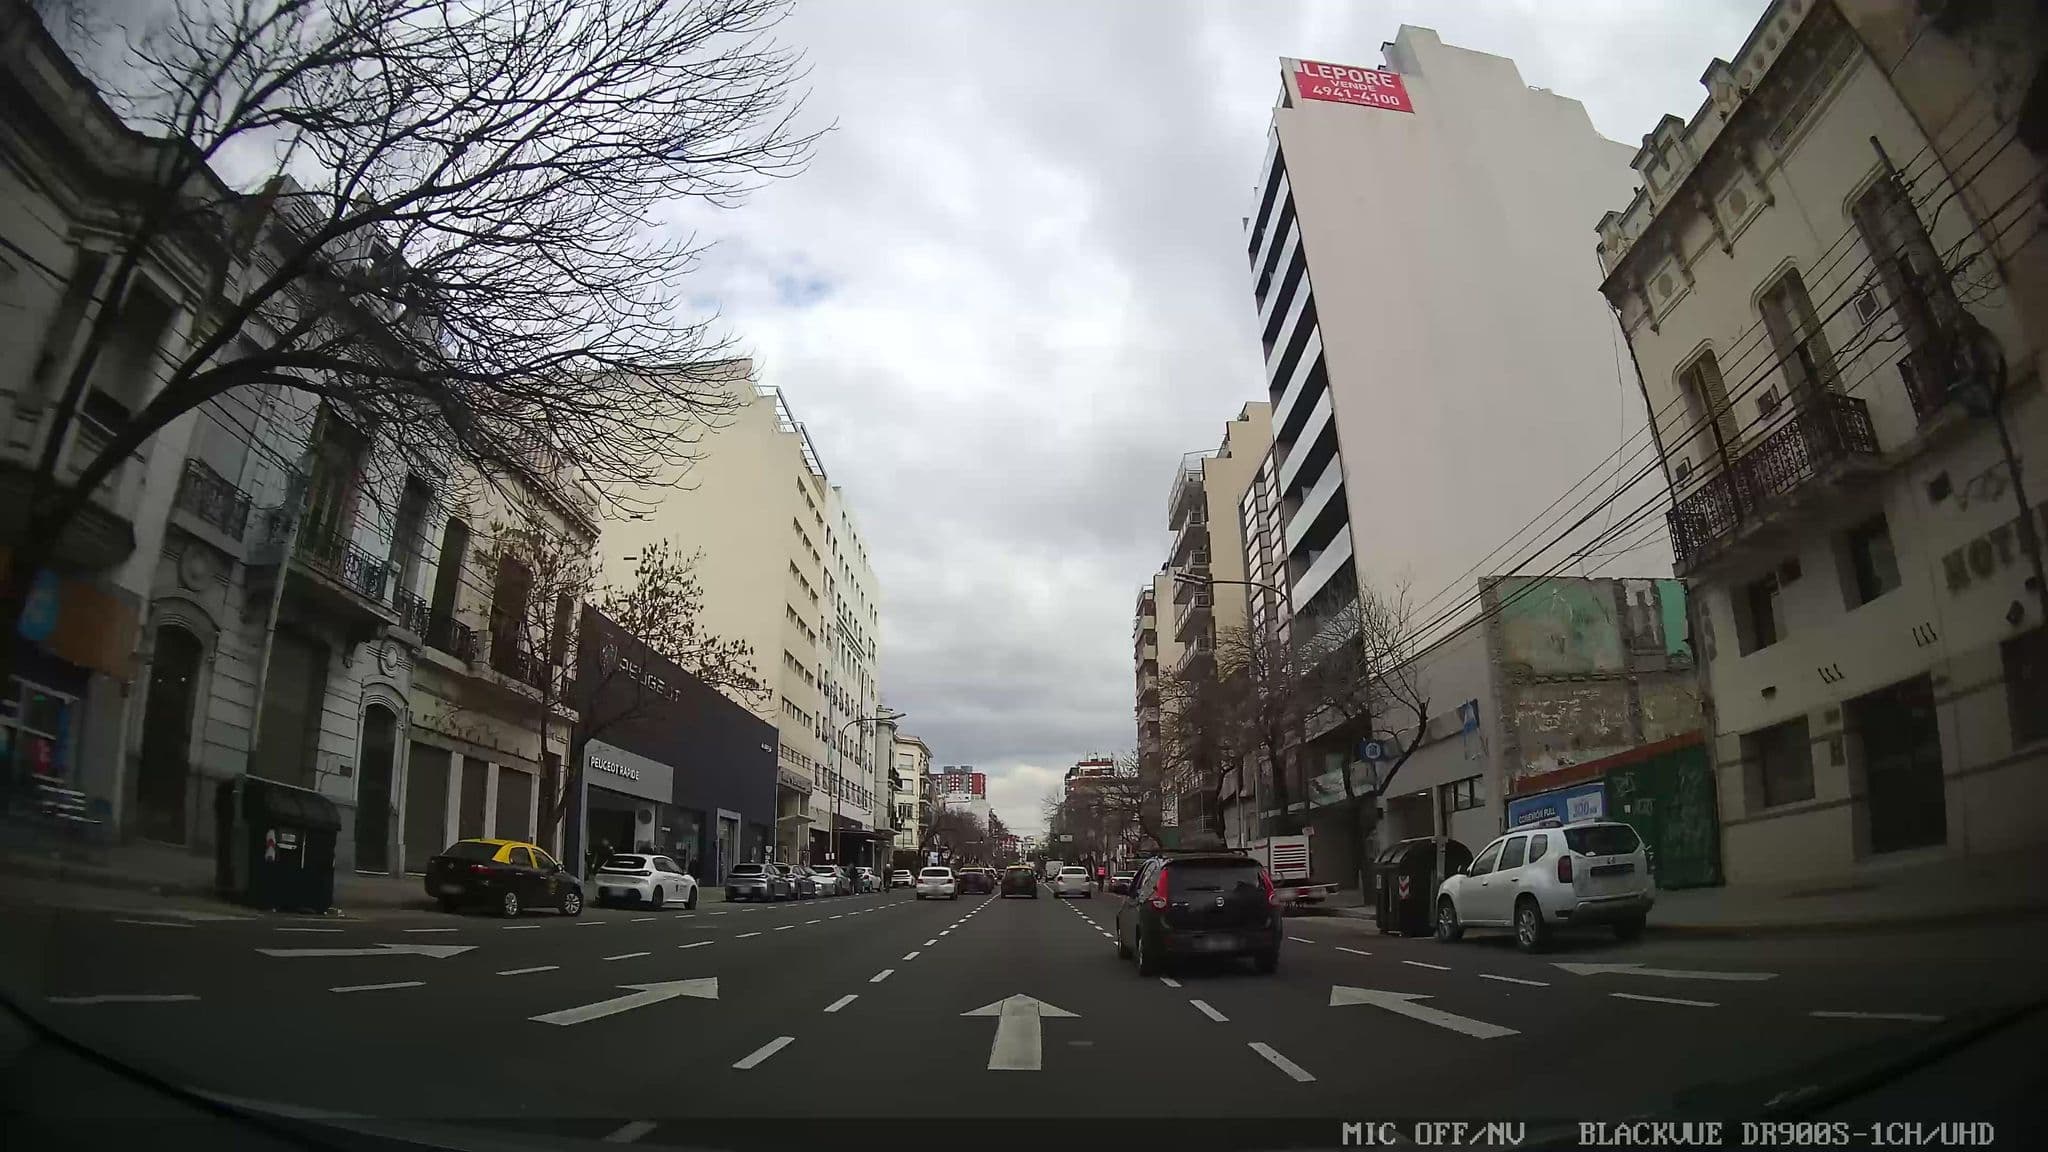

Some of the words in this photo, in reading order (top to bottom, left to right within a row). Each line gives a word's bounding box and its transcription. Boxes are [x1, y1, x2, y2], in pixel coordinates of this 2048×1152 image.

[1302, 62, 1395, 88] LEPORE
[1312, 85, 1400, 106] 4941-4100
[1329, 79, 1377, 93] VENDE
[590, 756, 619, 775] PEUGEOT
